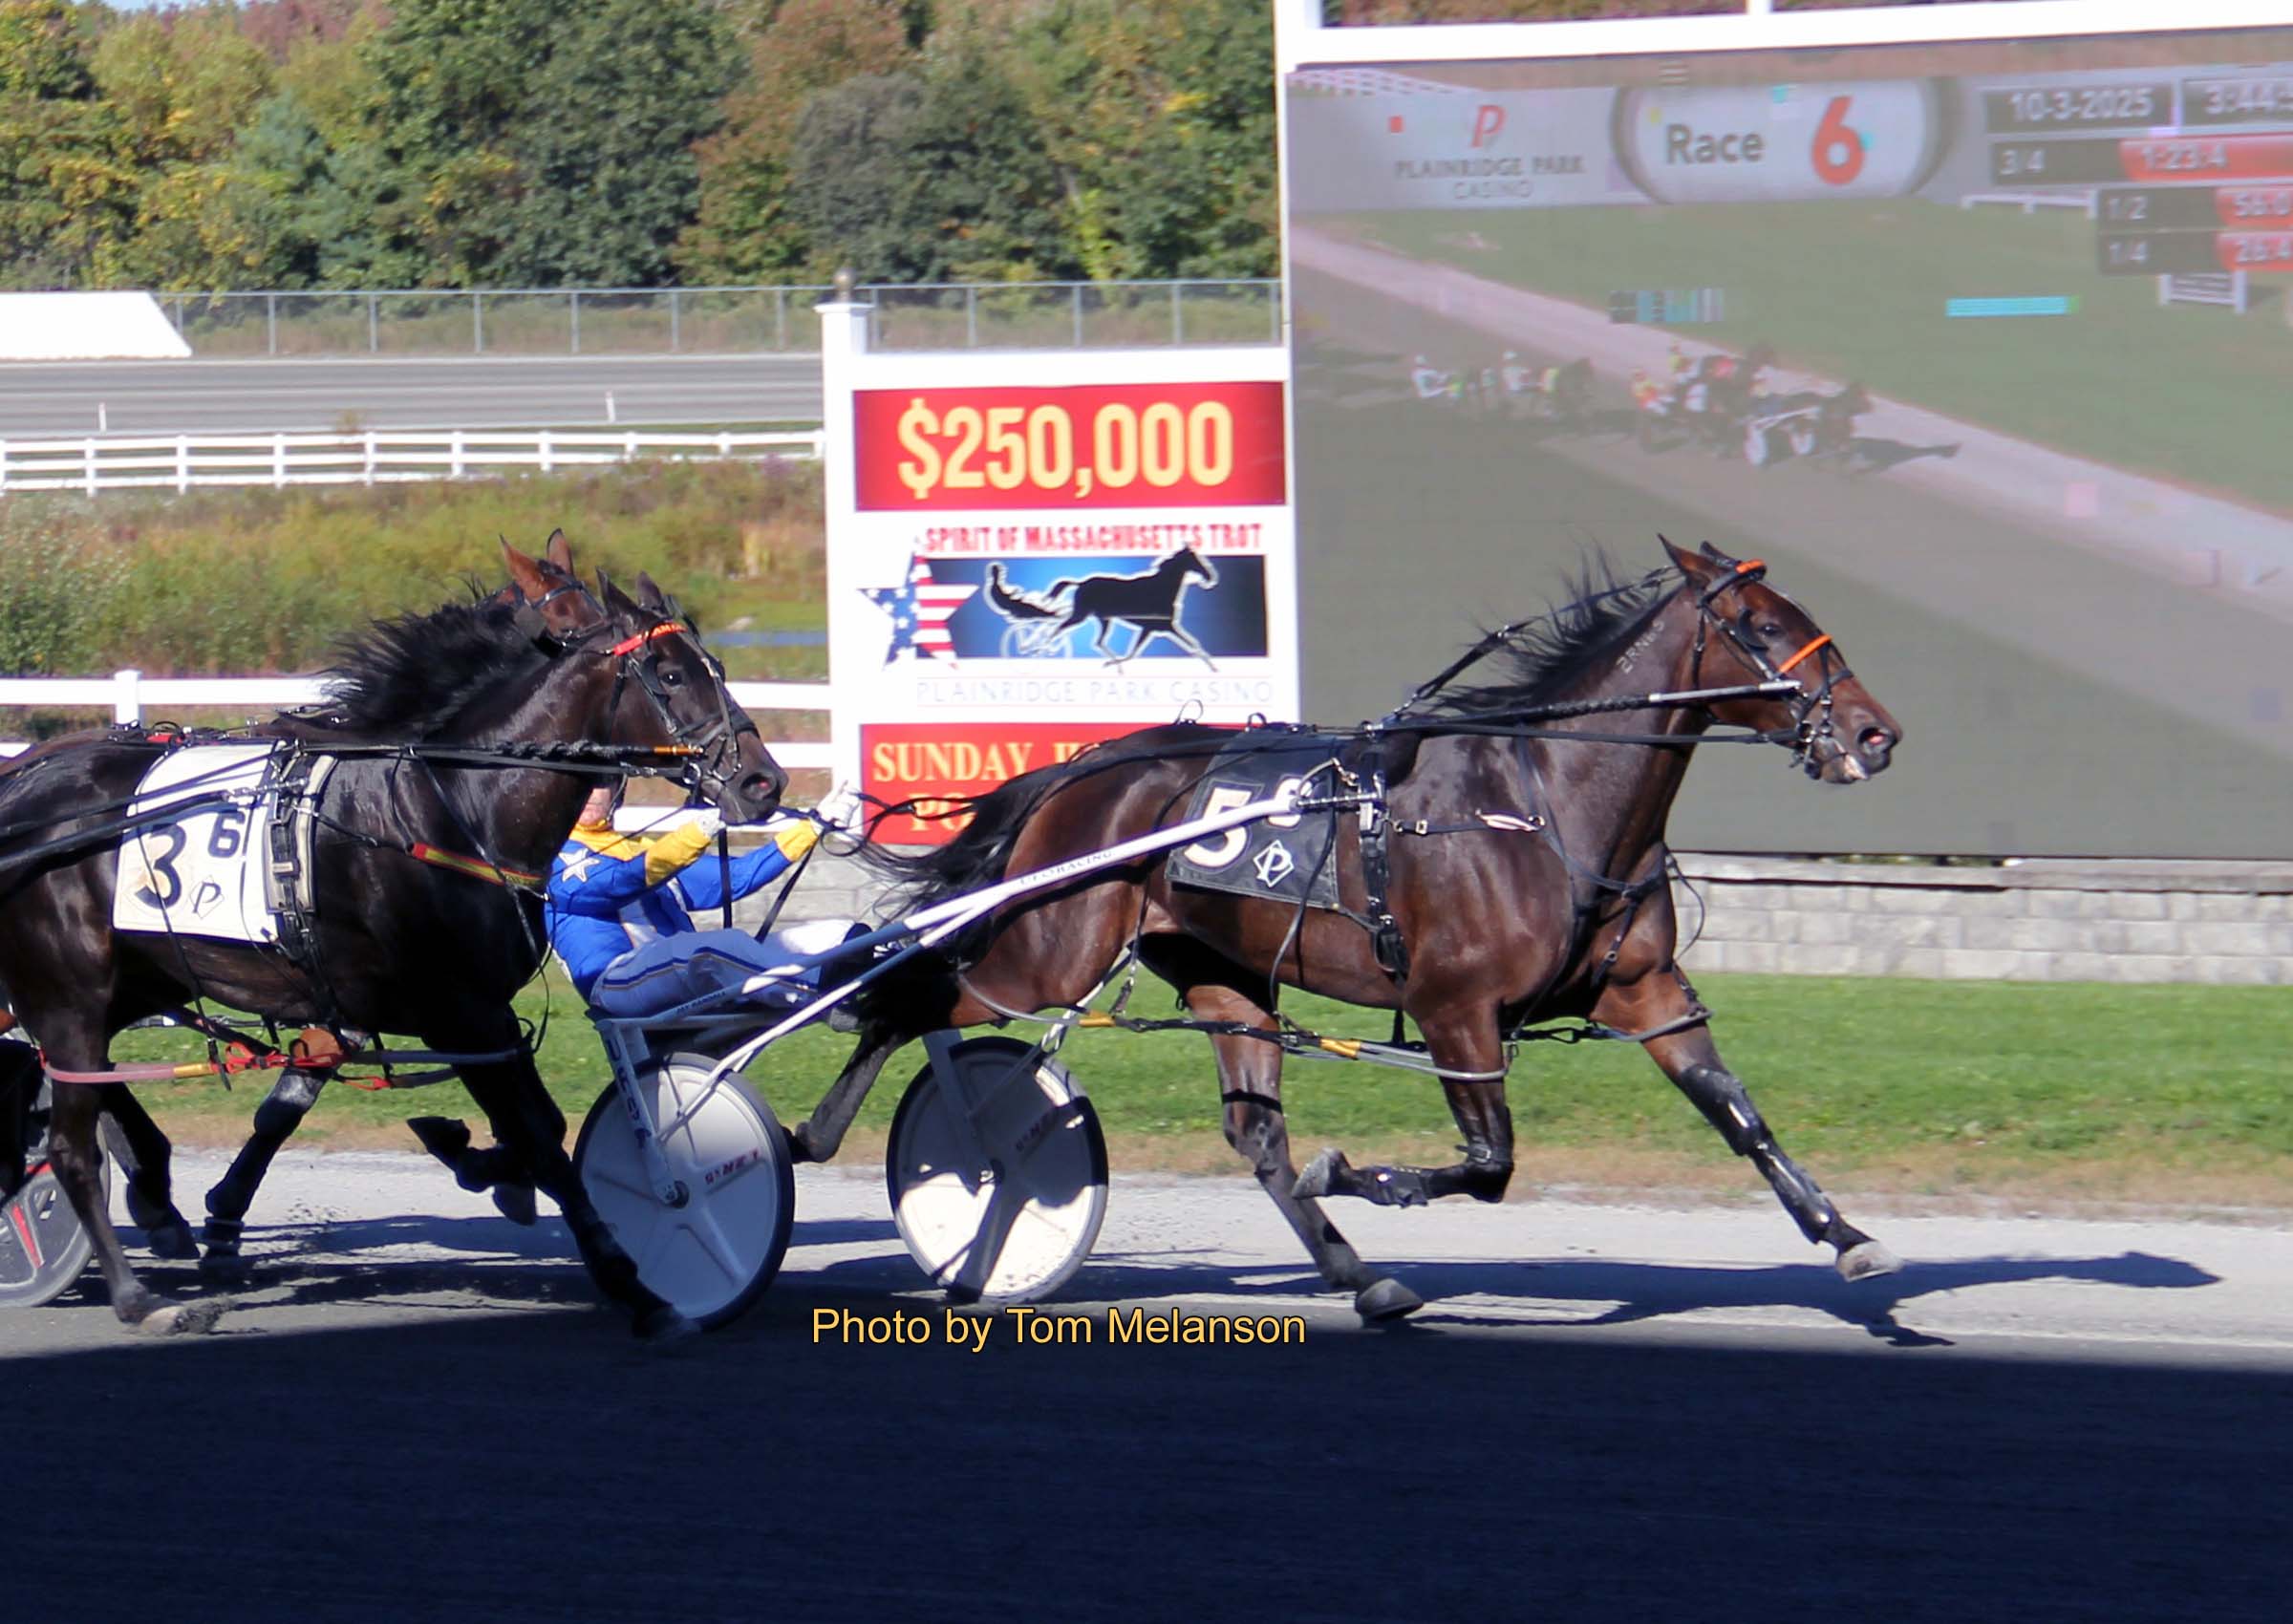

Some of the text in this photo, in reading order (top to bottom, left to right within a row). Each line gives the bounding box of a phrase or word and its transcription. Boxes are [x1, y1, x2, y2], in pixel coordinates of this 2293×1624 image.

[2010, 87, 2155, 121] 10-3-2025
[1665, 96, 1866, 185] Race 6
[1395, 155, 1586, 178] PLAINRIDGE PARK
[897, 397, 1233, 500] $250,000
[925, 526, 991, 552] SPIRIT
[996, 526, 1018, 551] OF
[917, 680, 1273, 703] PLAINRIDGE PARK CASINO
[873, 742, 1034, 781] SUNDAY
[207, 811, 246, 858] 6
[1184, 786, 1253, 867] 5
[135, 820, 186, 909] 3
